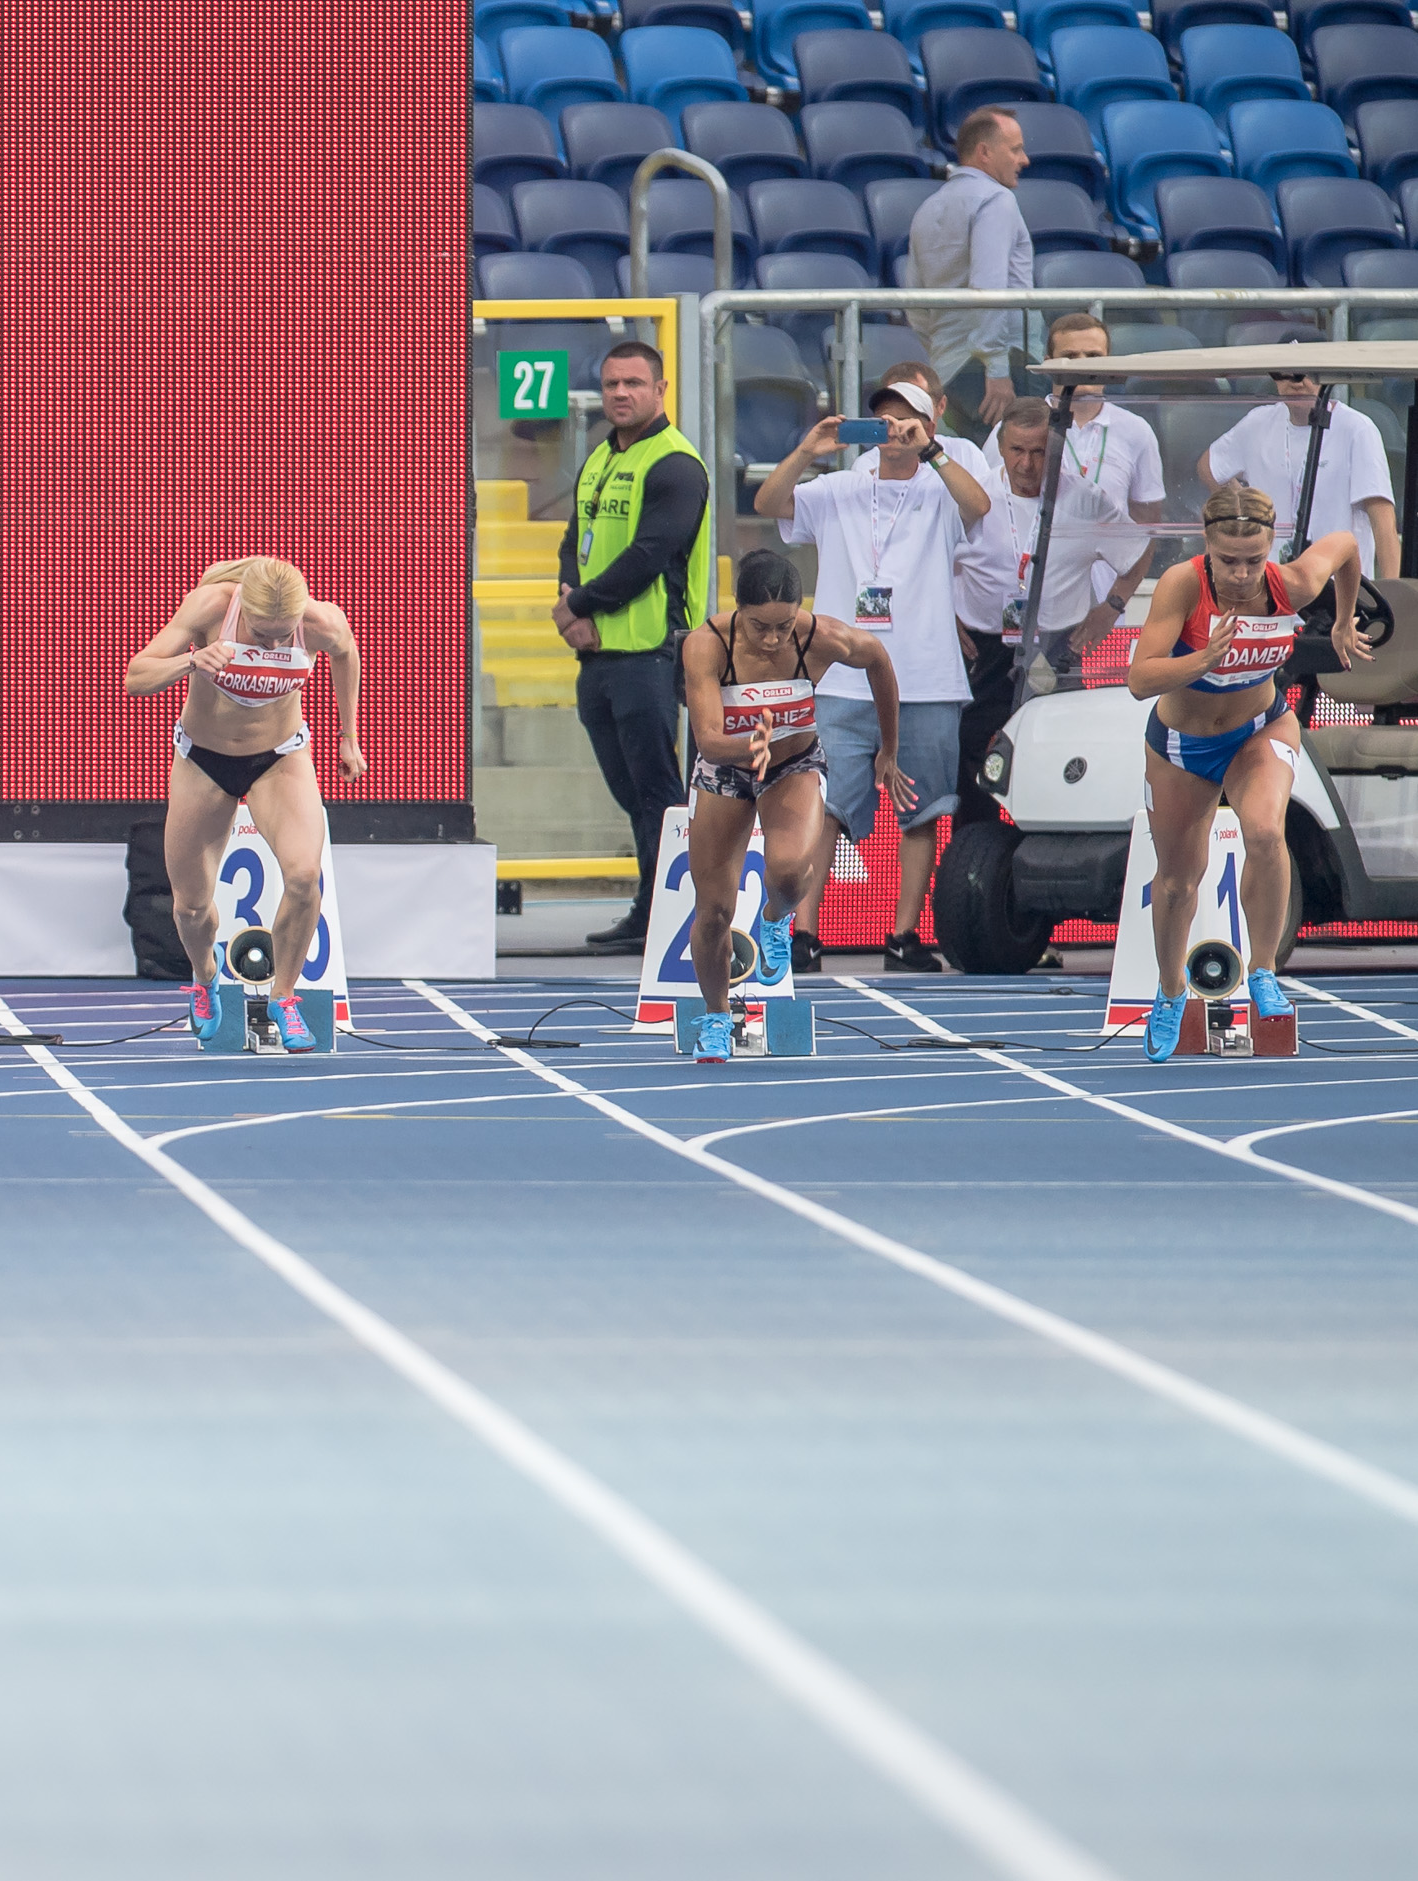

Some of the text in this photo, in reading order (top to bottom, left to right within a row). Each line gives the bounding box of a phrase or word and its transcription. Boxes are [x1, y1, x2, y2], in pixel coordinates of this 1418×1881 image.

[513, 361, 555, 409] 27
[1252, 623, 1277, 632] ORLEN
[263, 652, 291, 662] ORLEN
[763, 688, 791, 697] ORLEN
[725, 707, 811, 730] SANHEZ
[219, 847, 265, 981] 3
[657, 850, 699, 983] 2
[1217, 852, 1245, 986] 1
